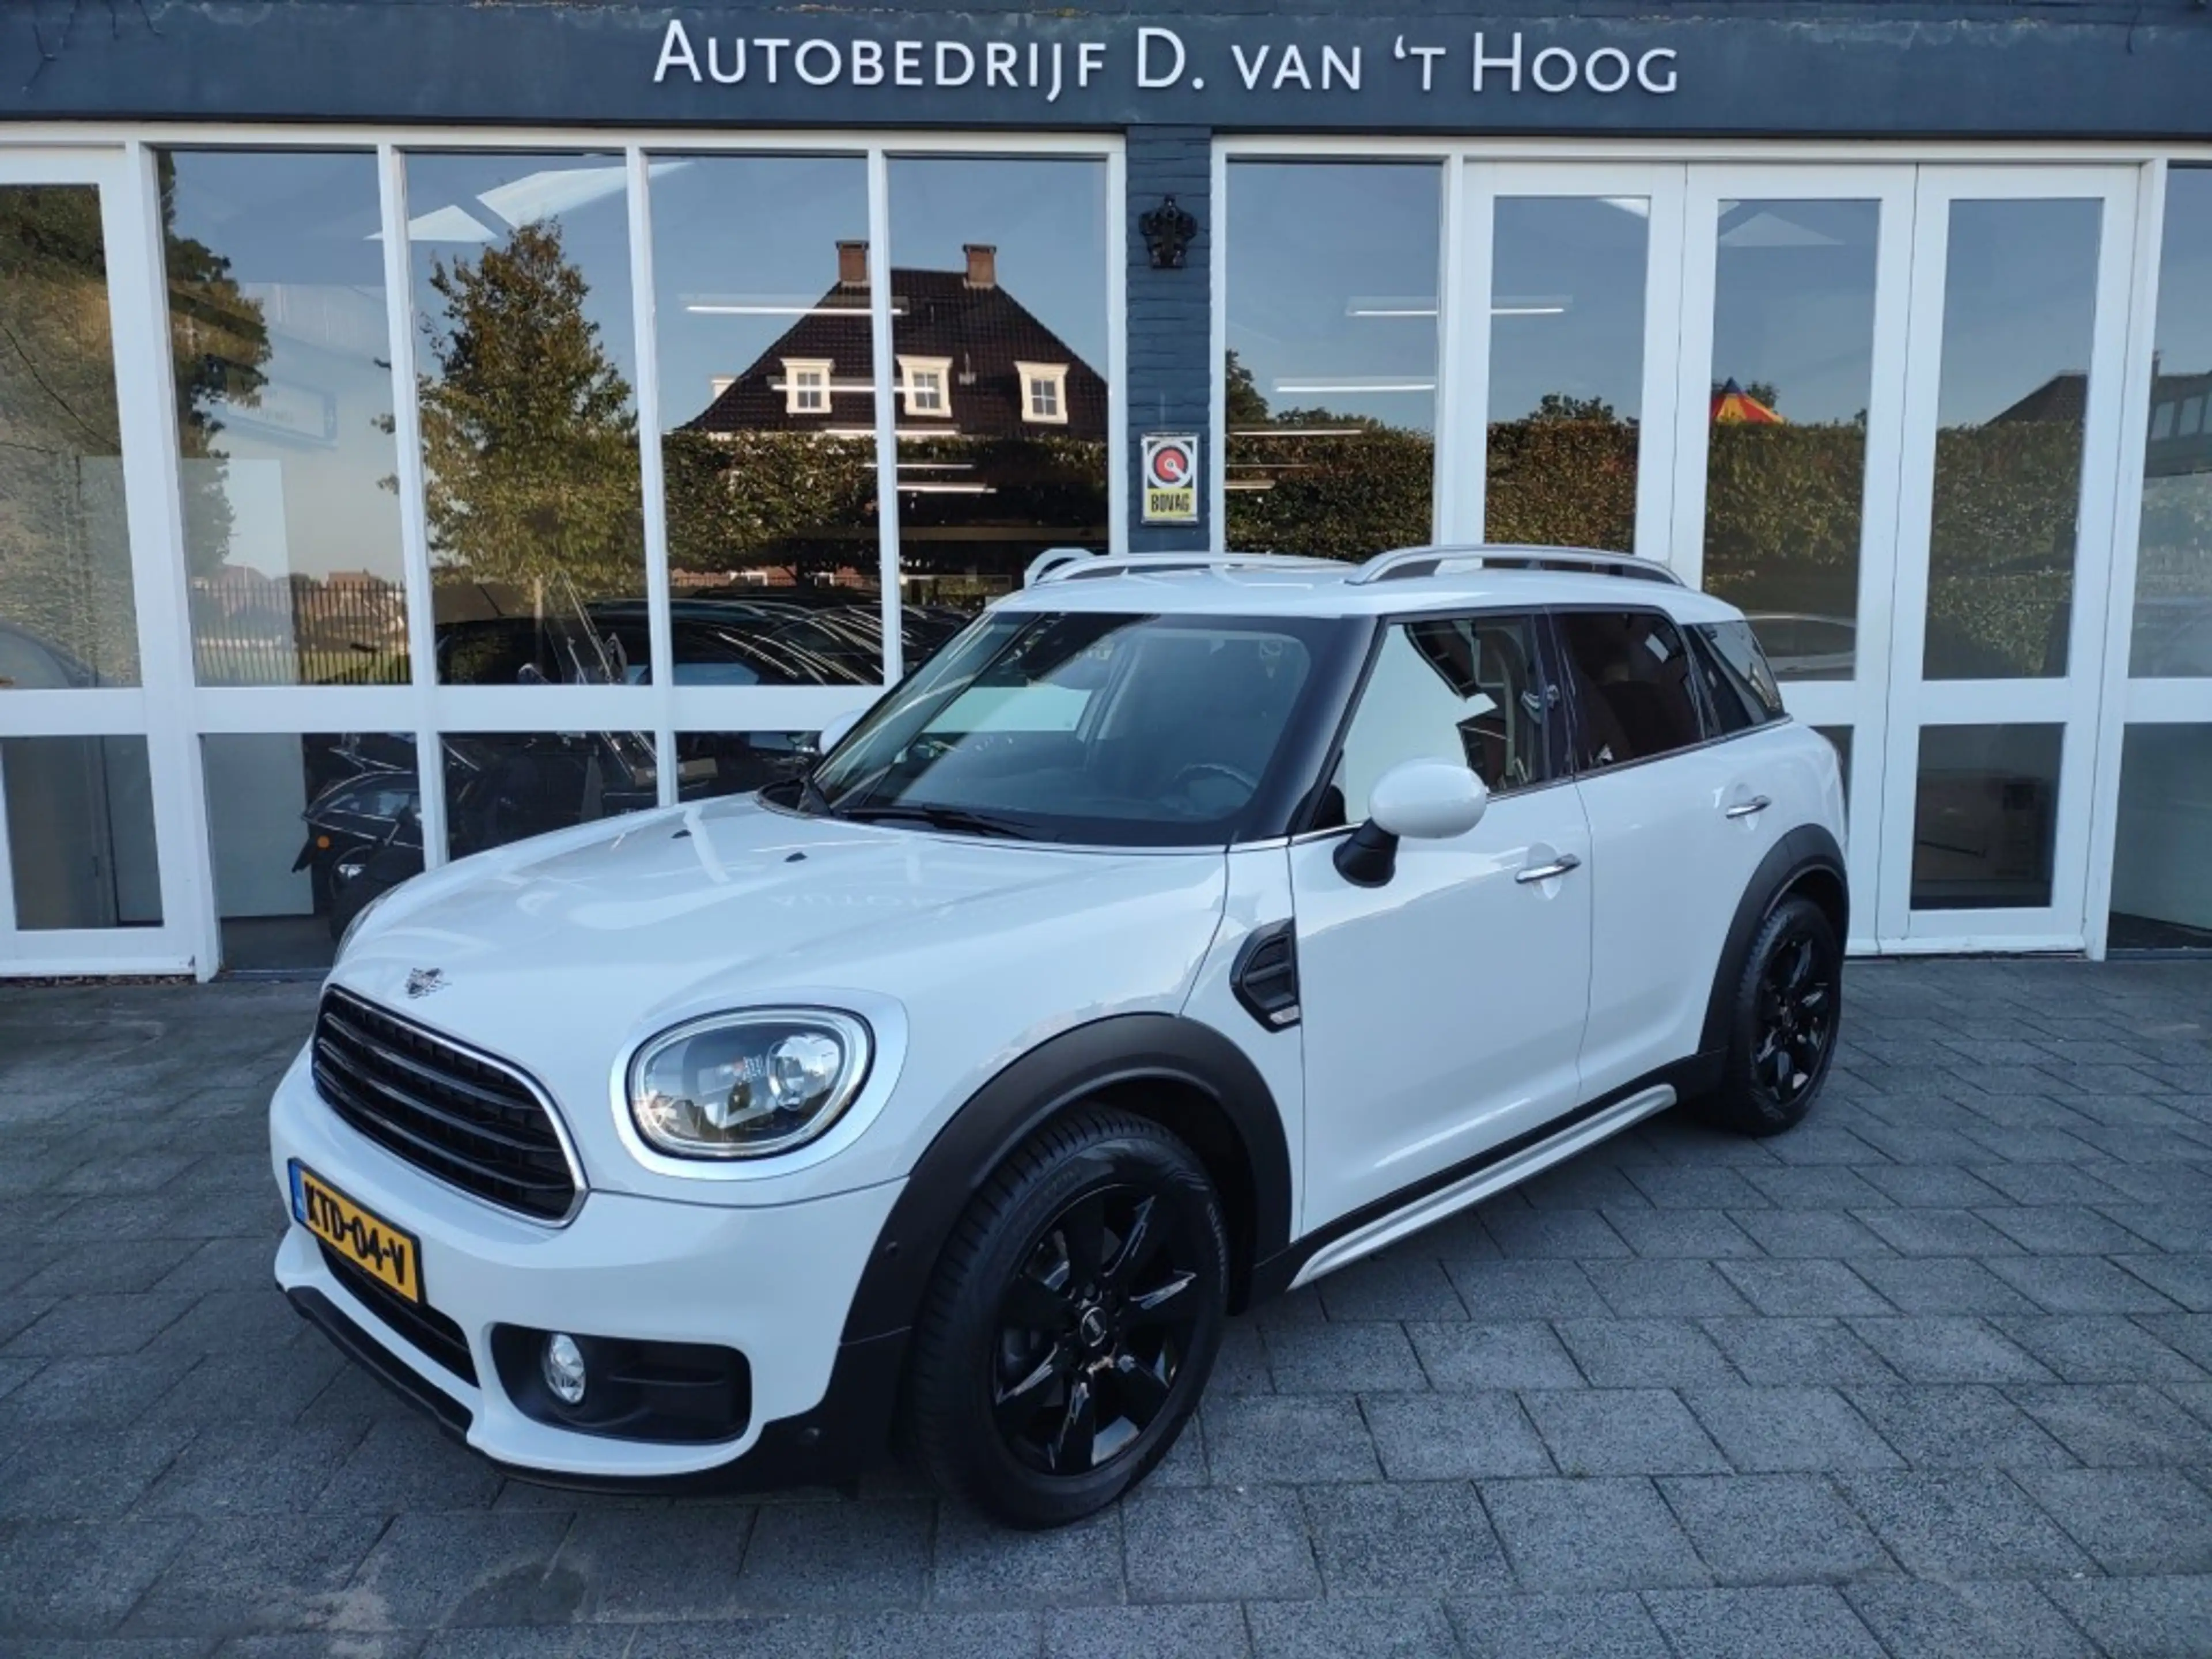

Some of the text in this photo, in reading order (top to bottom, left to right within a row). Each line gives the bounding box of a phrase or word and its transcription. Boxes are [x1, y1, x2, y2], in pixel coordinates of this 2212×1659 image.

[653, 19, 1106, 102] AUTOBEDRIJF
[1137, 27, 1205, 90] D.
[1231, 45, 1361, 90] VAN
[1473, 32, 1677, 93] HOOG
[1151, 493, 1190, 512] BOVAG
